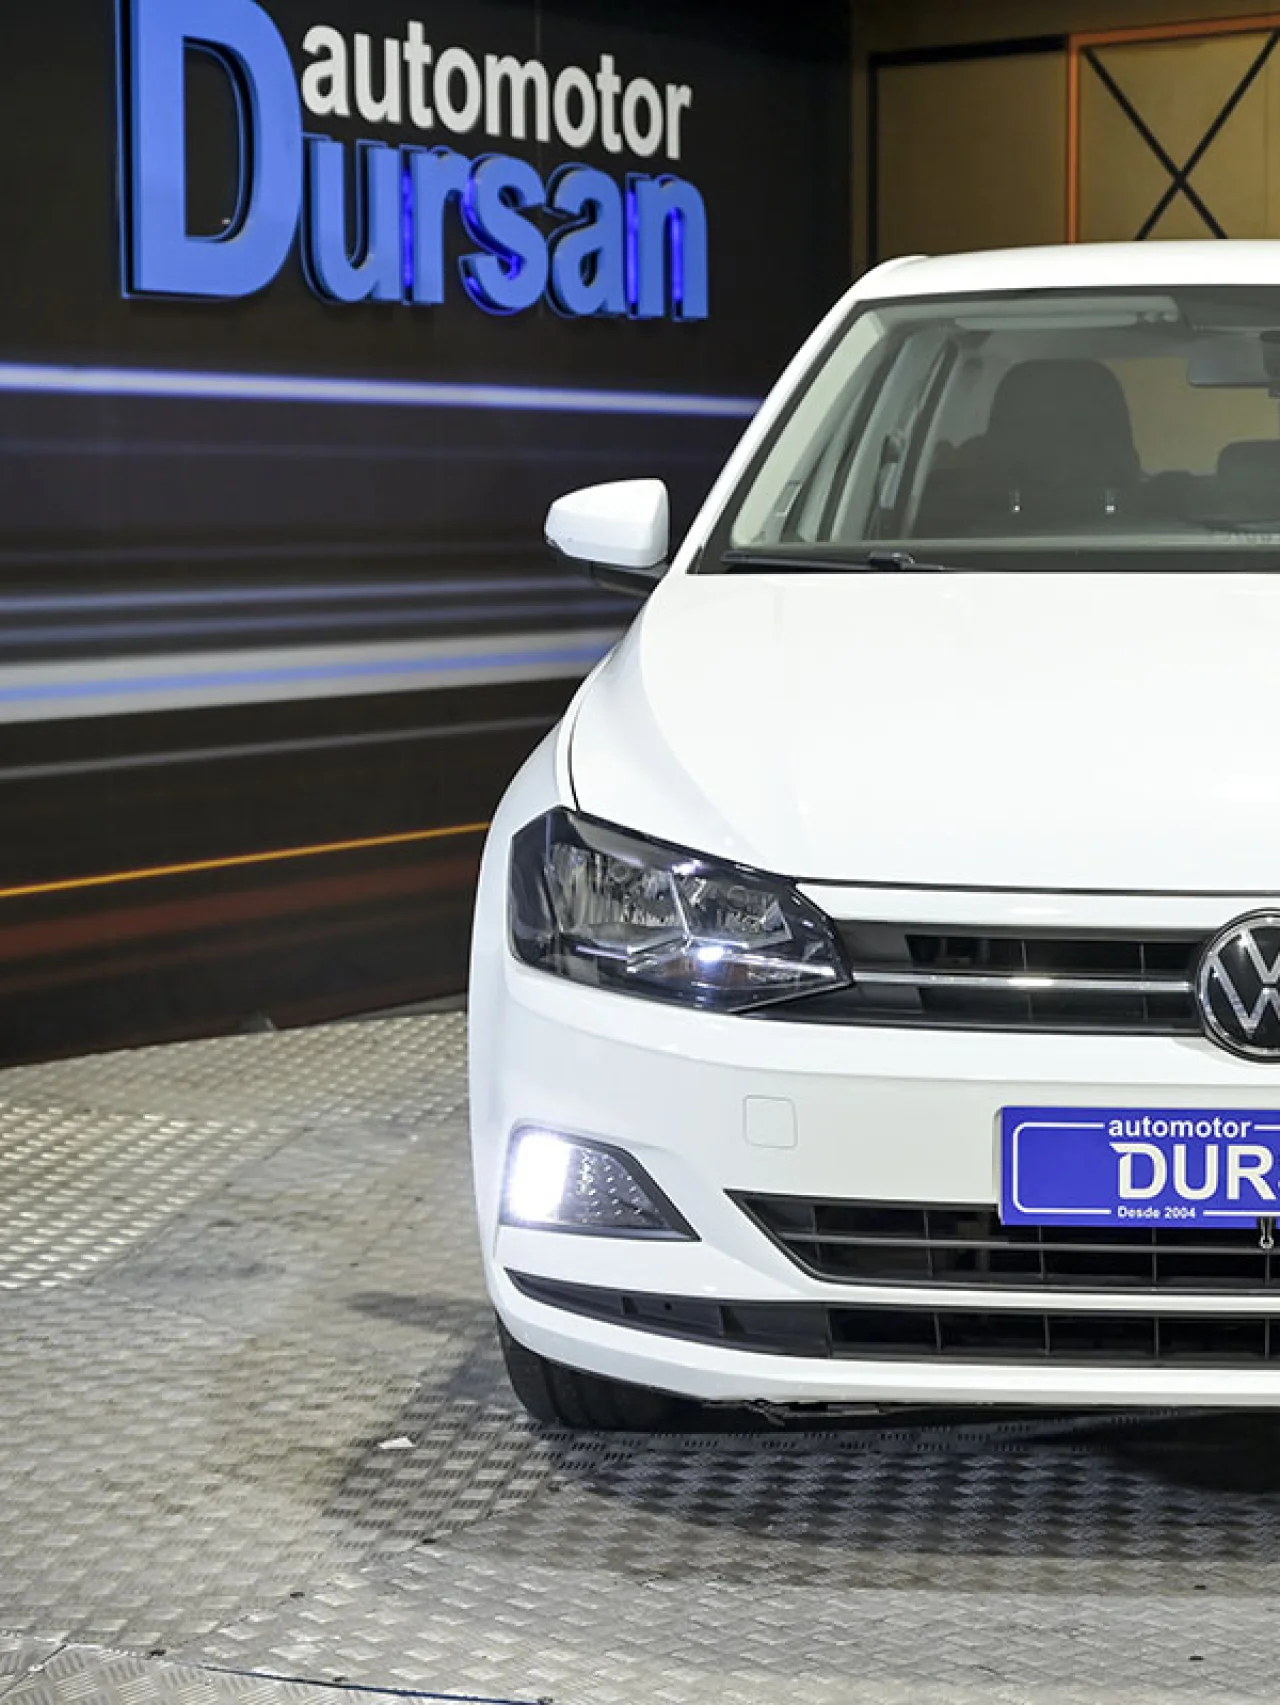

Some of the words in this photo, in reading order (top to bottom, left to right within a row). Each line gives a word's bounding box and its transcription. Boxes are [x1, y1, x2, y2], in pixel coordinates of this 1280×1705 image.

[302, 21, 692, 160] automotor
[118, 0, 709, 321] Dursan
[1108, 1117, 1252, 1139] automotor
[1117, 1205, 1160, 1219] Desde
[1164, 1205, 1196, 1219] 2004
